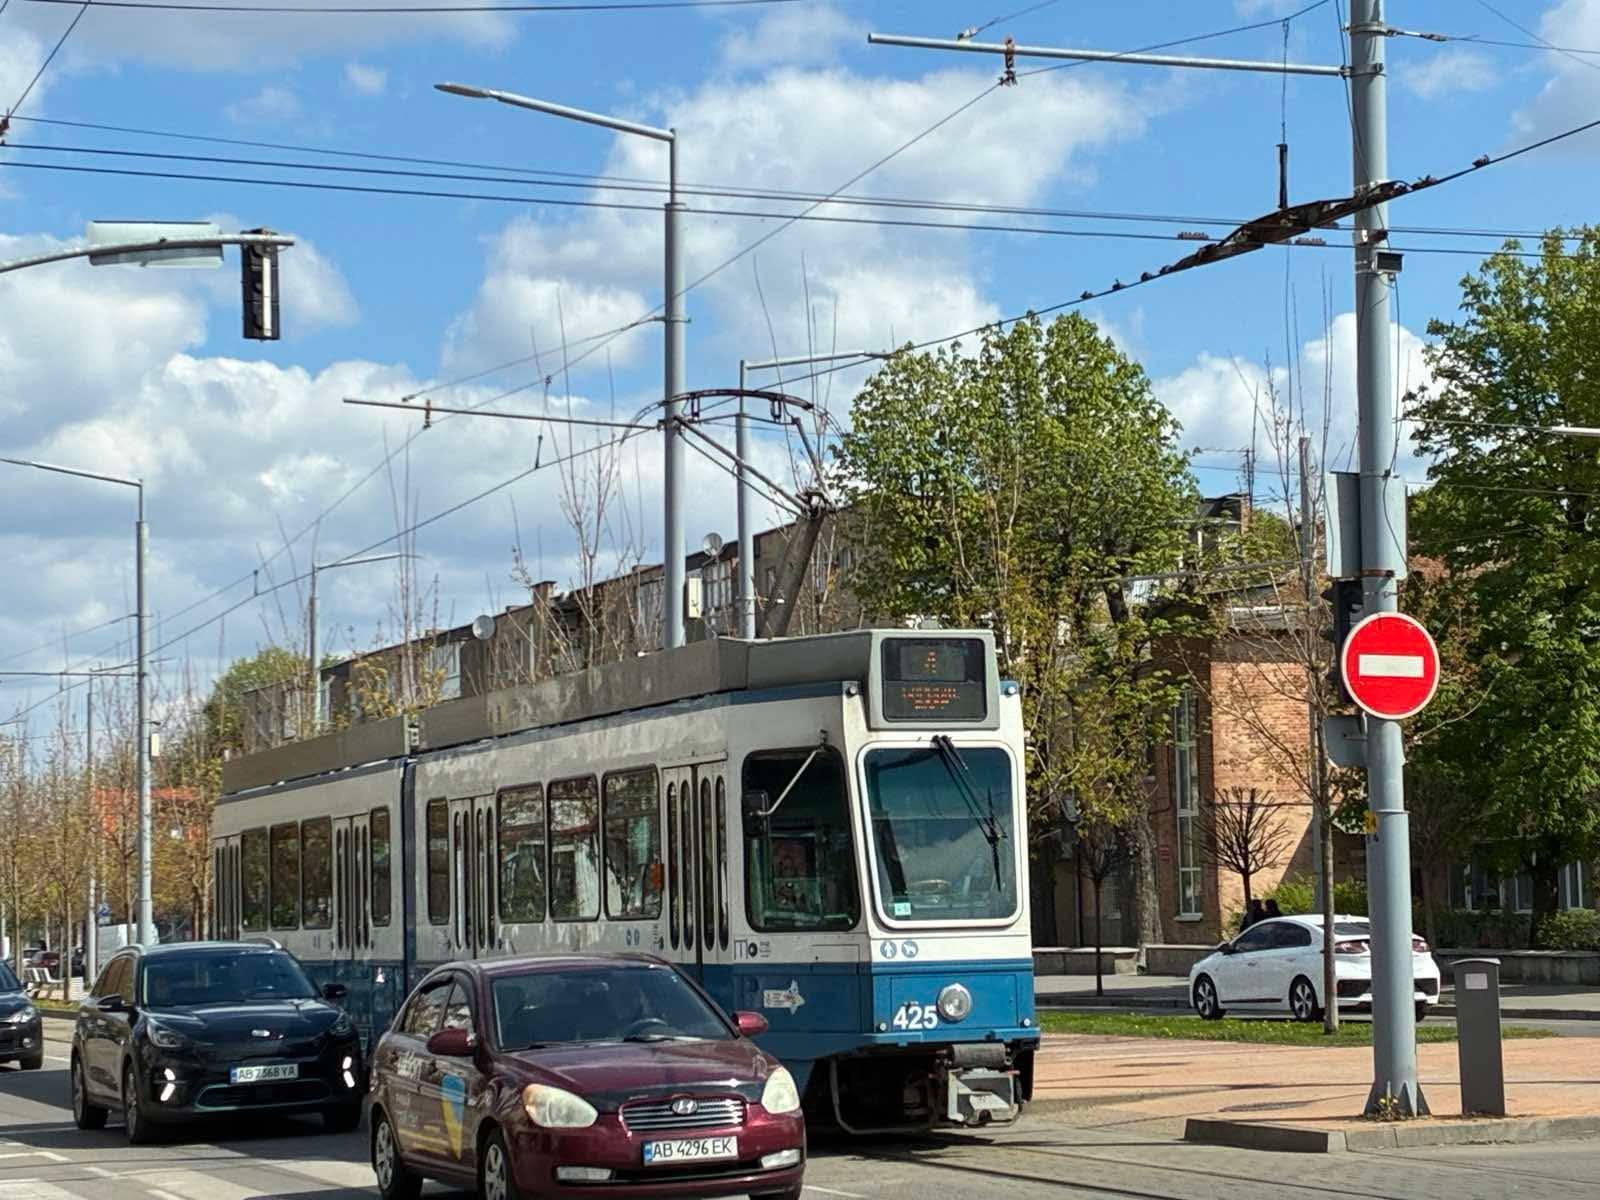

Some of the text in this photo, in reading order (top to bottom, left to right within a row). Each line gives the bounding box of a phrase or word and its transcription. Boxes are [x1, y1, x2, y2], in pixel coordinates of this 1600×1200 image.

[893, 1005, 938, 1031] 425
[240, 1069, 254, 1080] AB
[653, 1139, 732, 1157] AB 4296 EK
